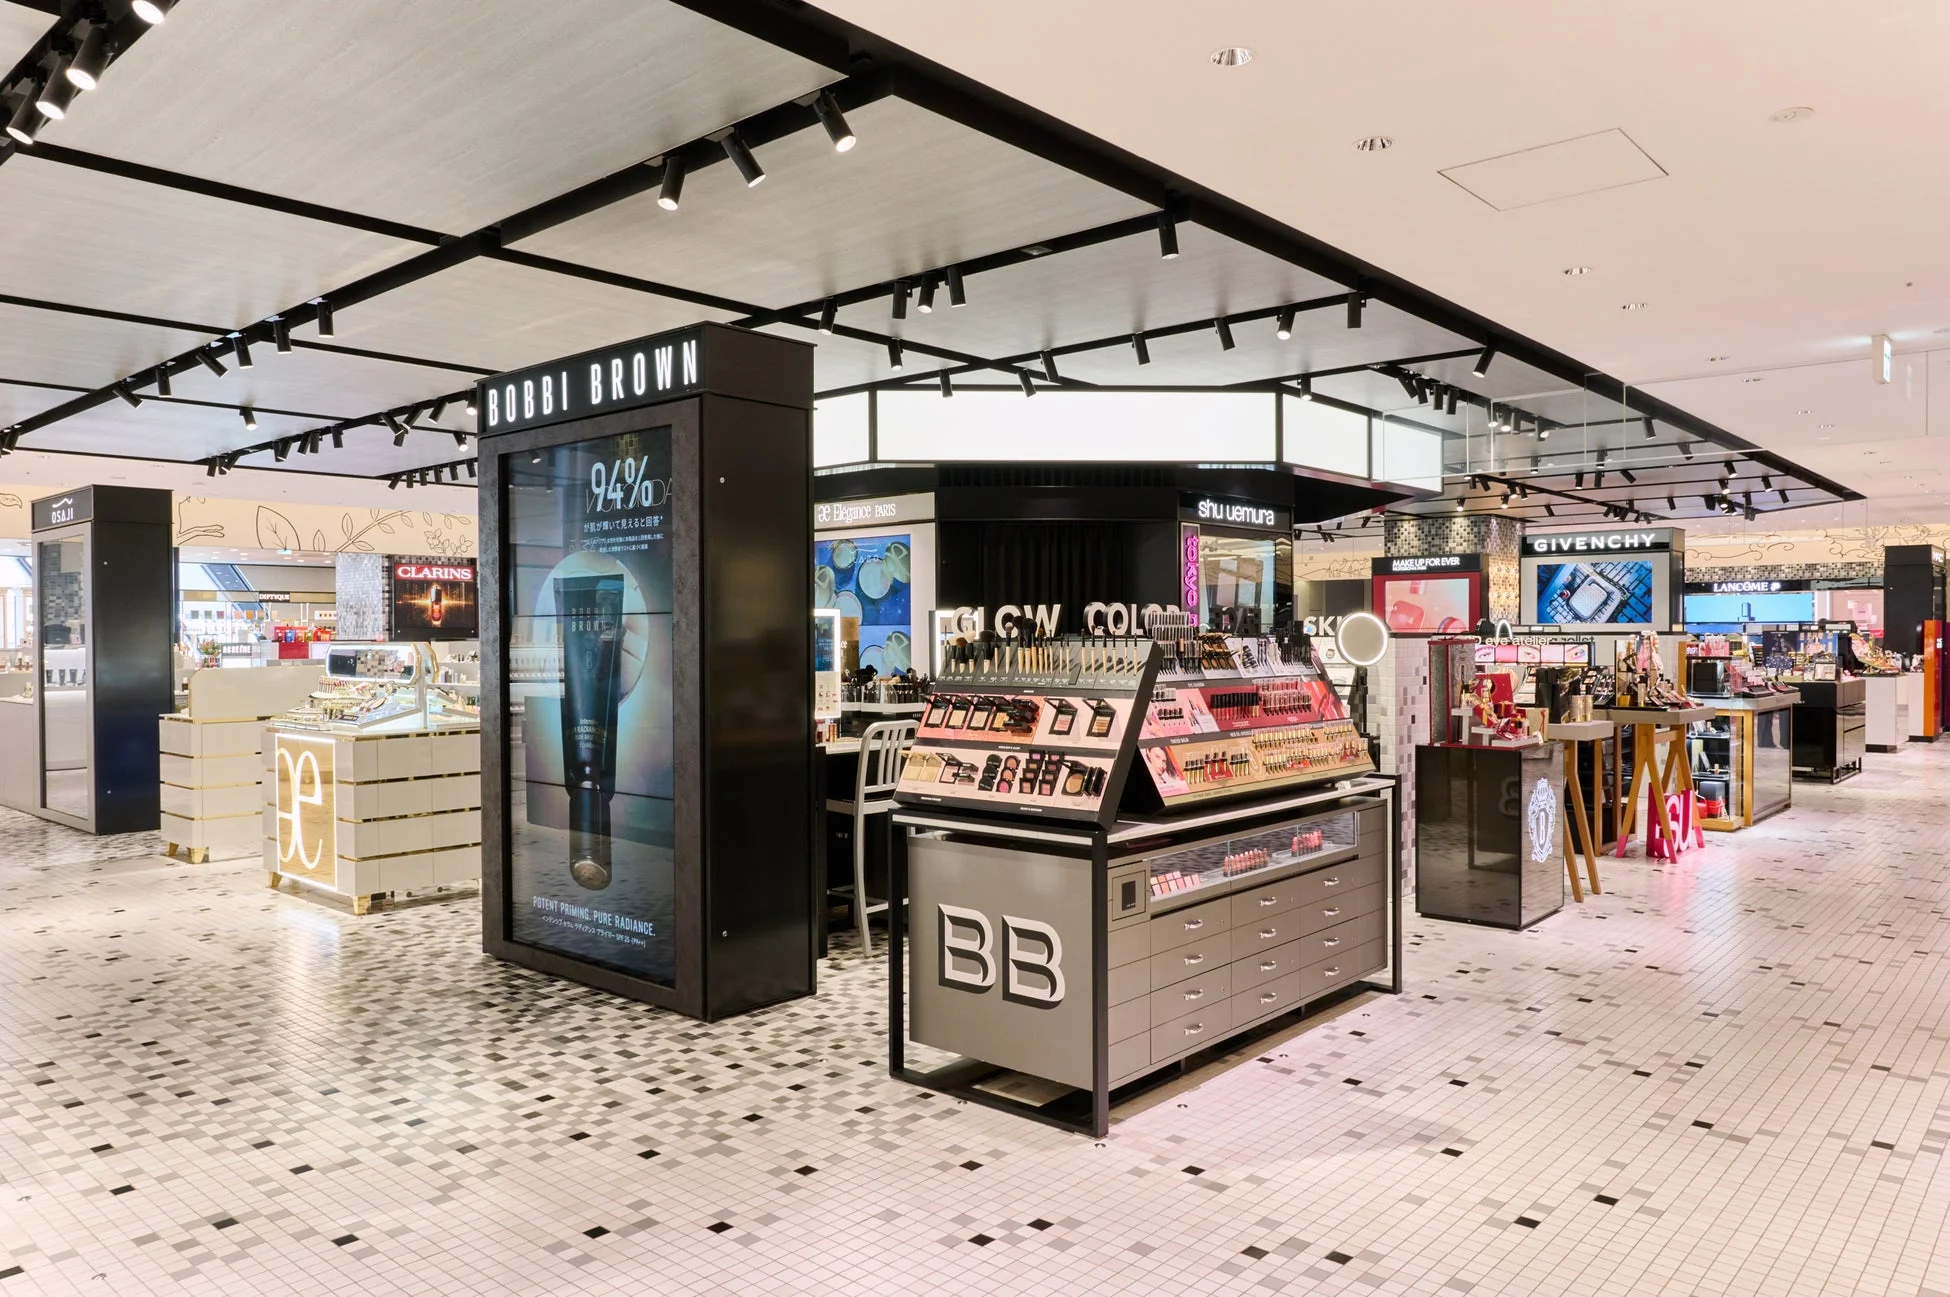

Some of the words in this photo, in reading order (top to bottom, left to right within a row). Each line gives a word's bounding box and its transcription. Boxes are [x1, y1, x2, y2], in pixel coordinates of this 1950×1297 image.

[488, 371, 568, 427] BOBBI
[590, 339, 697, 405] BROWN
[591, 455, 652, 512] 94%
[51, 507, 74, 524] OSAJI
[875, 503, 896, 518] PARIS
[1198, 499, 1223, 519] shu
[1226, 504, 1275, 525] uemura
[1534, 533, 1656, 553] GIVENCHY
[1185, 536, 1199, 606] tokyo
[1392, 559, 1414, 567] MAKE
[1415, 559, 1424, 567] UP
[1425, 558, 1441, 567] FOR
[1442, 557, 1461, 566] EVER
[397, 566, 473, 580] CLARINS
[1713, 581, 1769, 593] LANCÔME
[1511, 635, 1553, 646] atelier
[533, 896, 558, 912] POTENT
[560, 902, 592, 921] PRIMING.
[594, 910, 613, 926] PURE
[614, 915, 656, 936] RADIANCE.
[937, 903, 1066, 1010] BB
